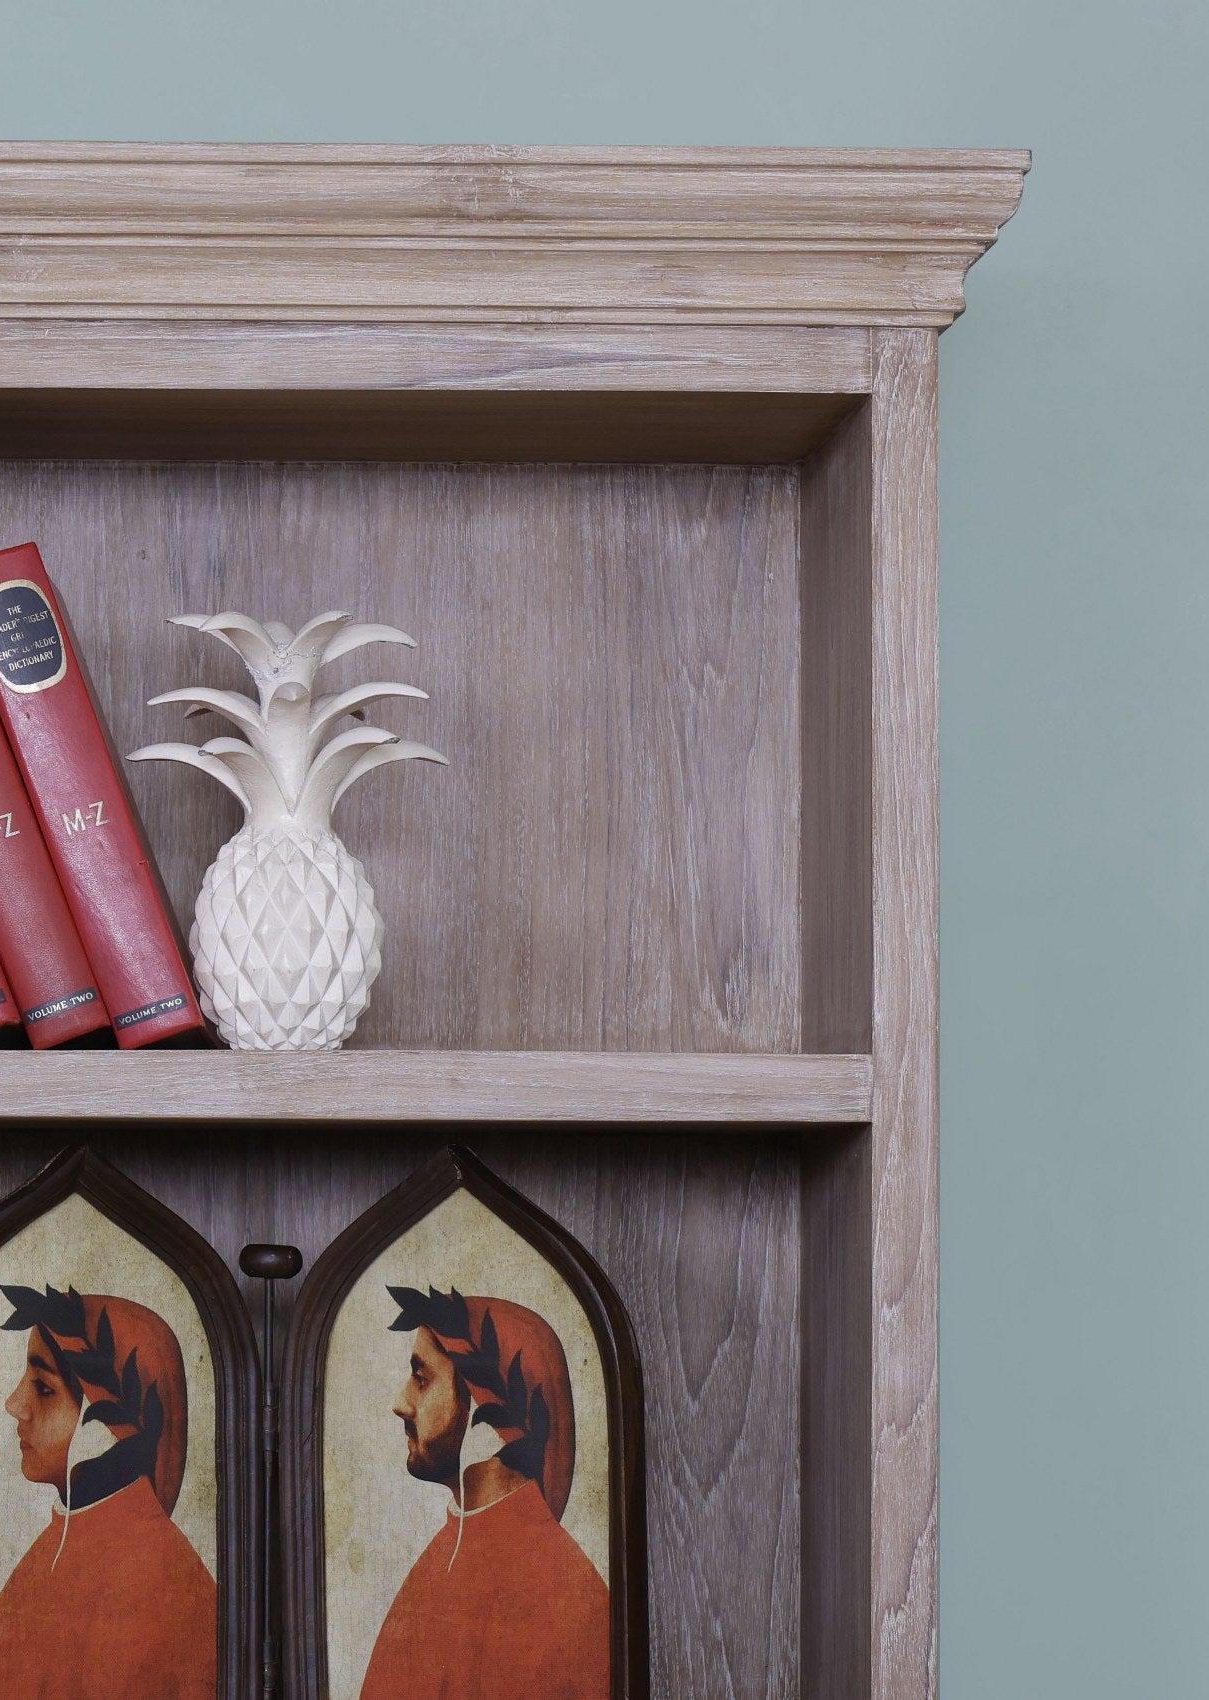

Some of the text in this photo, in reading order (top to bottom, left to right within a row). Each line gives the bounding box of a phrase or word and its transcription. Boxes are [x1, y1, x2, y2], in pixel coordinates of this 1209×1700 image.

[6, 605, 22, 616] THE
[8, 650, 54, 671] DICTIONARY
[62, 801, 110, 836] M-Z
[28, 992, 94, 1021] VOLUME TWO
[120, 998, 183, 1025] VOLUME TWO
